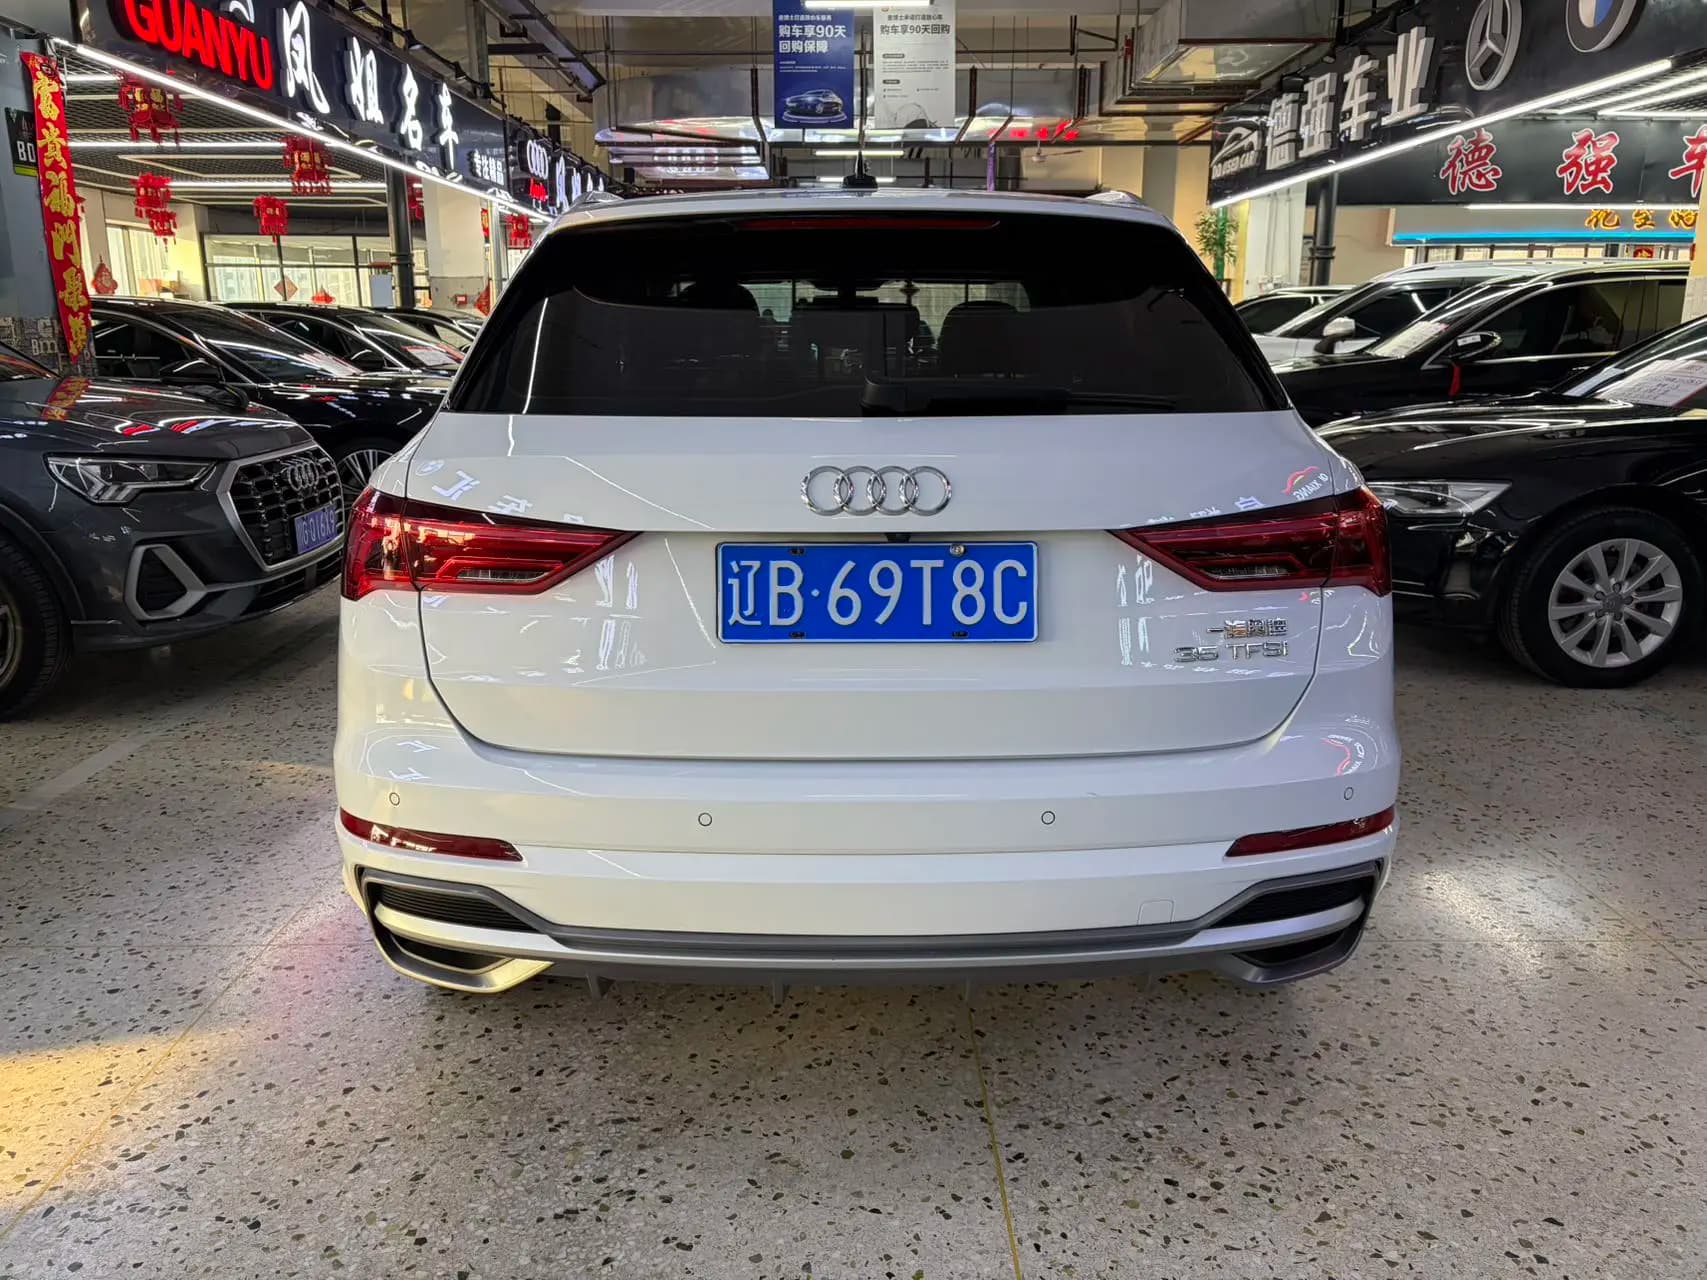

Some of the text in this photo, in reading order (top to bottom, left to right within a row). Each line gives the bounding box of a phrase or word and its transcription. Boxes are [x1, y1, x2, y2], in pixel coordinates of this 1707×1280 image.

[778, 24, 847, 38] 购车享90天
[880, 24, 951, 35] 购车享90天回购
[123, 0, 274, 91] GUANYU
[778, 40, 829, 53] 回购保障
[727, 559, 1028, 627] 辽B·69T8C
[1174, 640, 1289, 663] 35 TFSI
